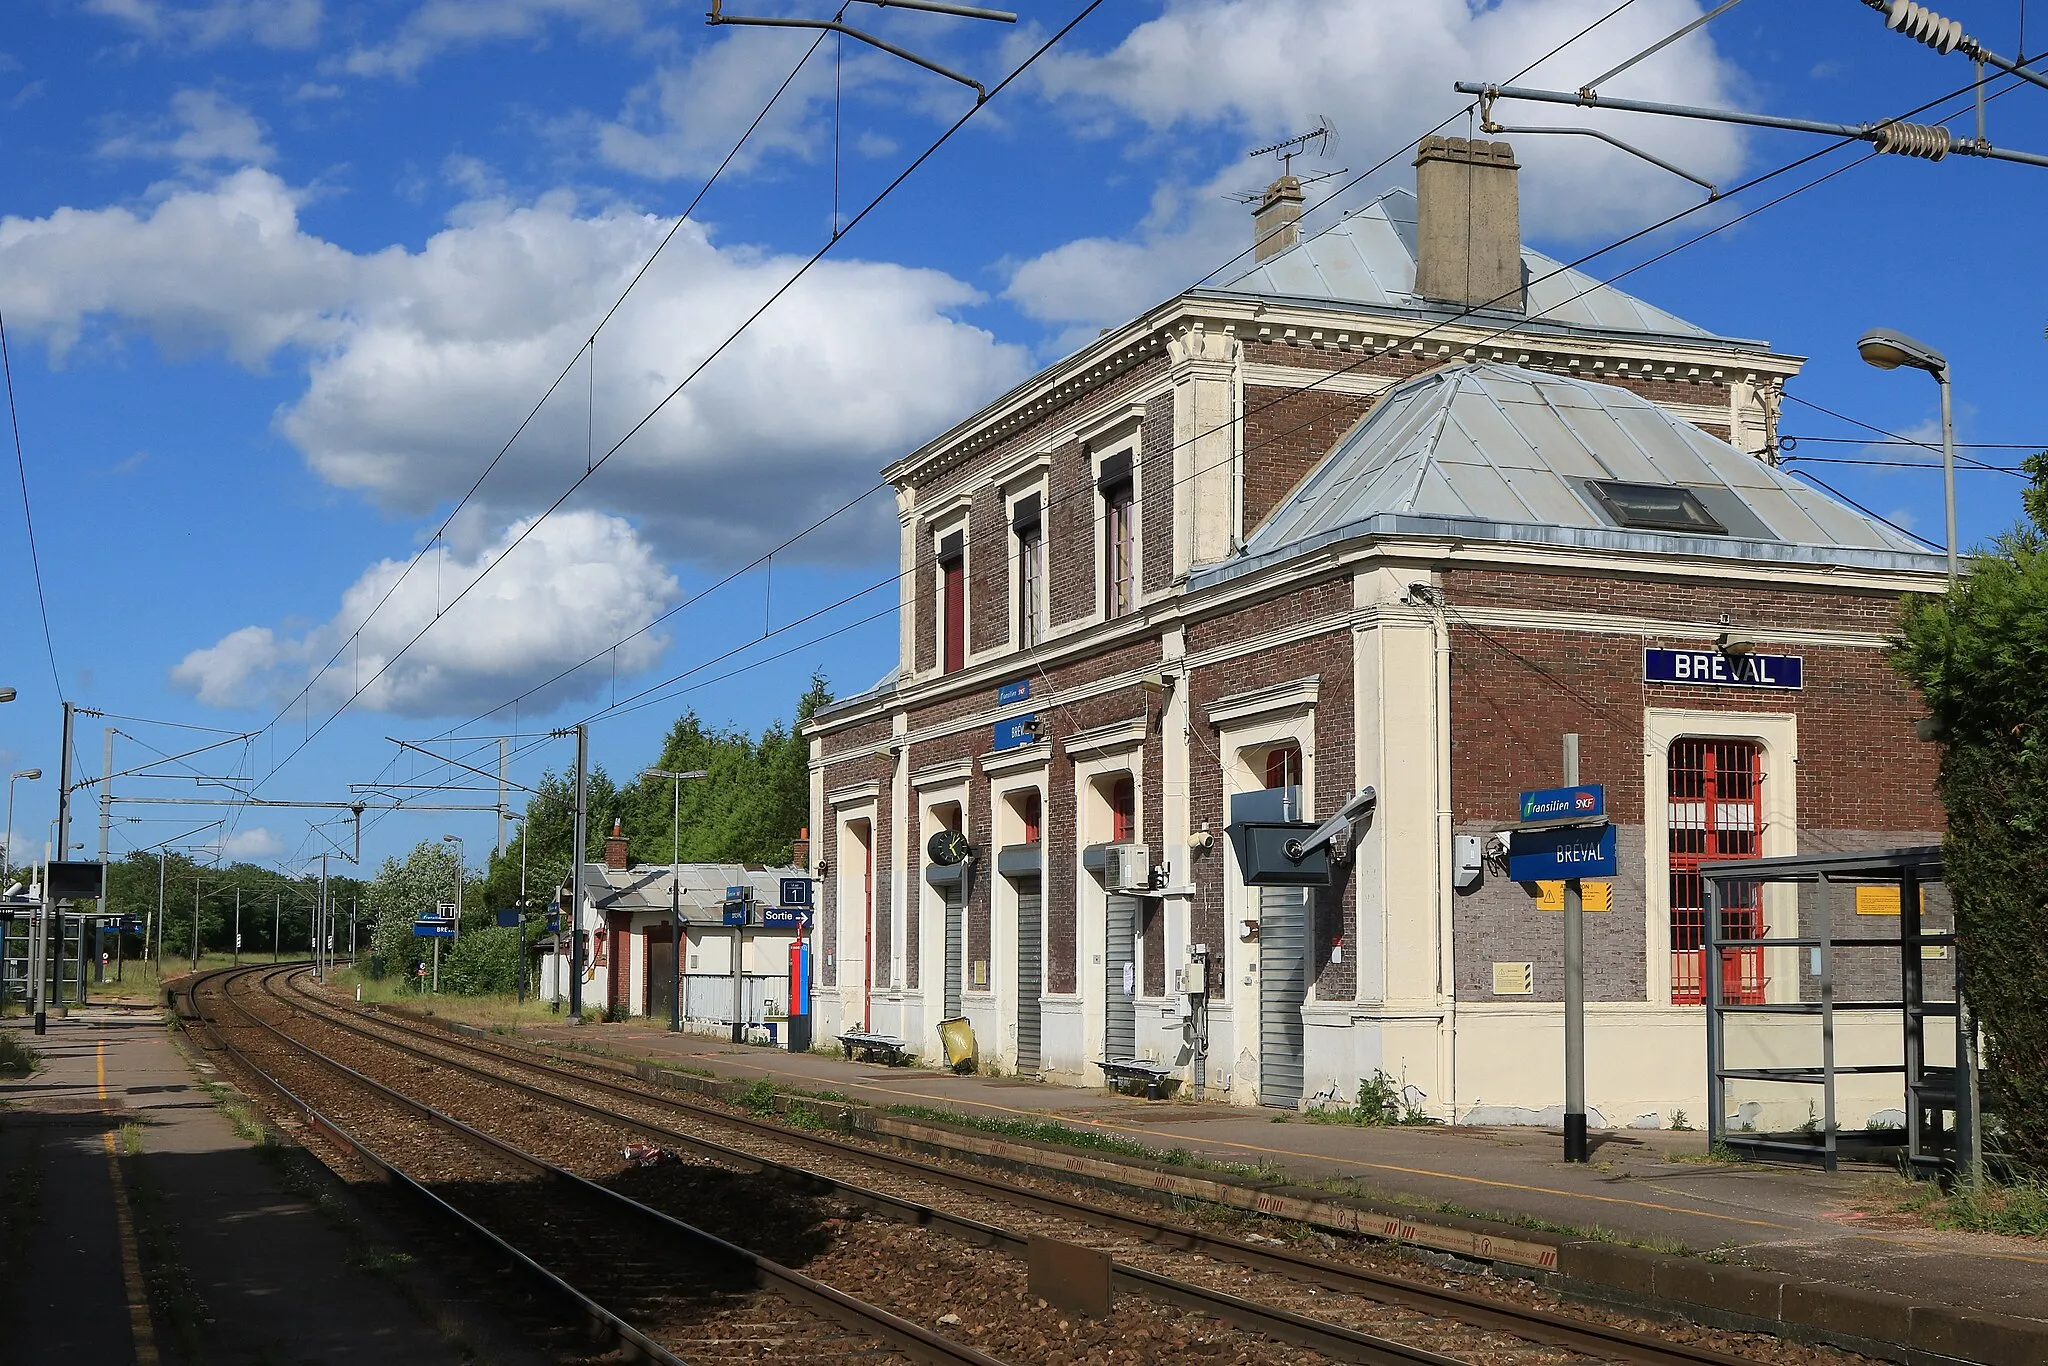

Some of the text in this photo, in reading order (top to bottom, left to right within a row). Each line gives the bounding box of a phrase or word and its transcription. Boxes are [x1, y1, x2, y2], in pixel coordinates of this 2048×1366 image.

[1527, 799, 1569, 813] Transilien
[1575, 797, 1594, 809] SNCF
[1556, 839, 1605, 863] BRÉVAL
[791, 889, 797, 902] 1
[765, 911, 793, 920] Sortie
